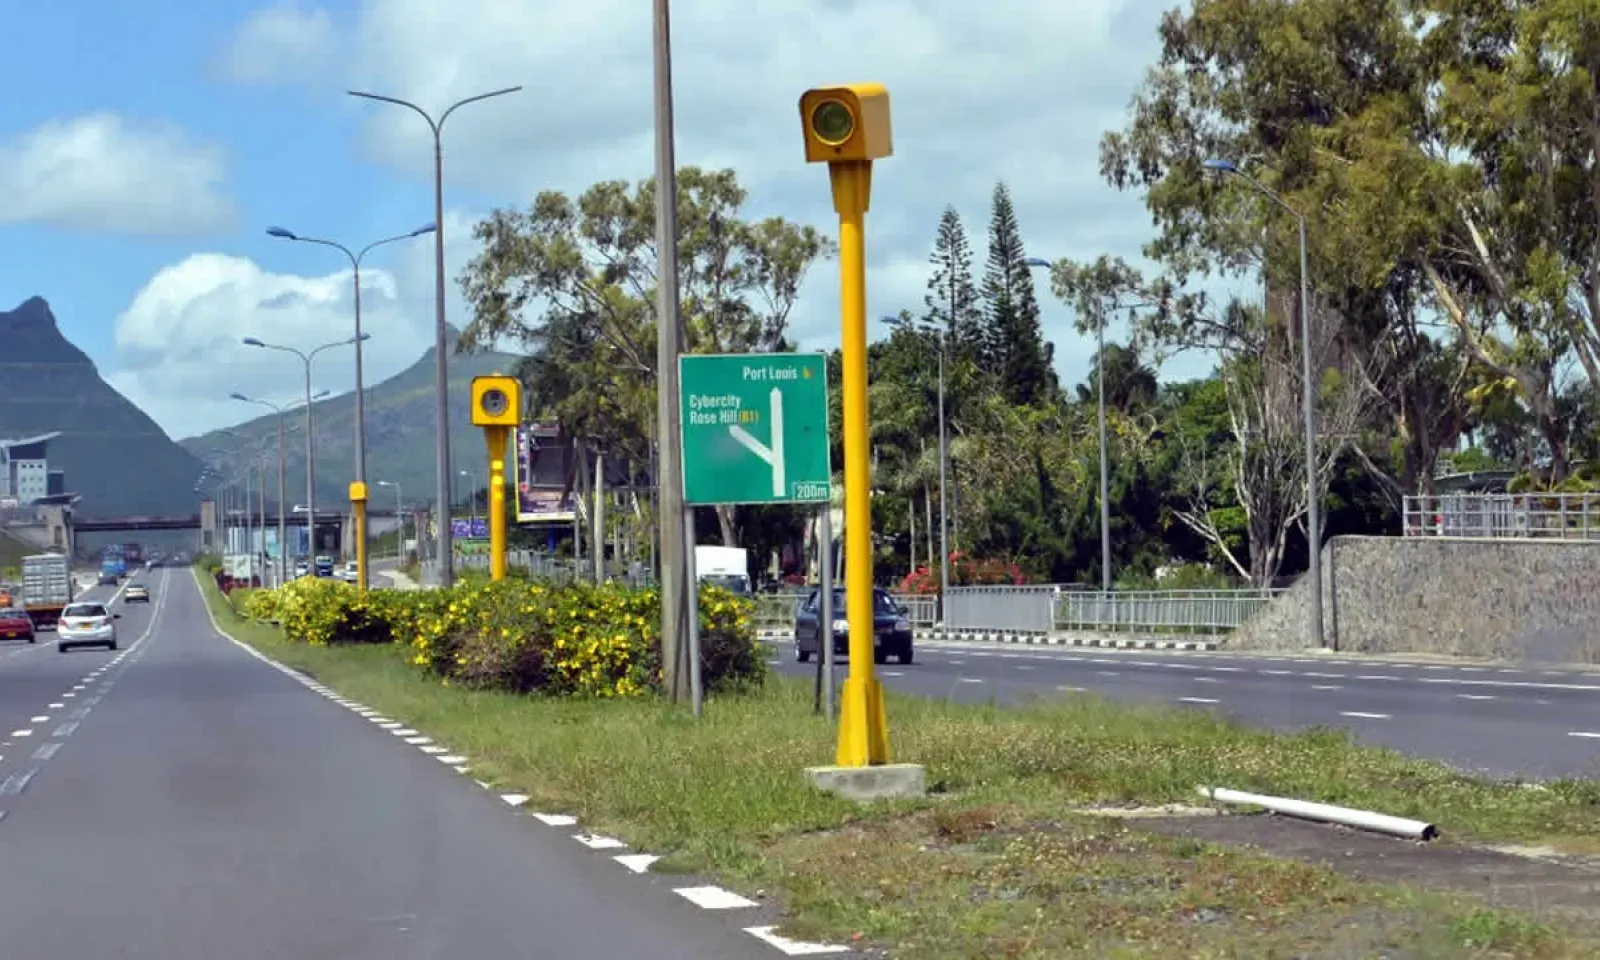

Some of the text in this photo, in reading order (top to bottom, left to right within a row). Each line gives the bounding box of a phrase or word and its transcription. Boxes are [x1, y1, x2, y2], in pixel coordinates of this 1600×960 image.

[743, 365, 798, 380] Port Louis
[689, 394, 741, 410] Cybercity
[690, 410, 717, 424] Rose
[720, 409, 738, 423] Hill
[797, 484, 827, 498] 200m
